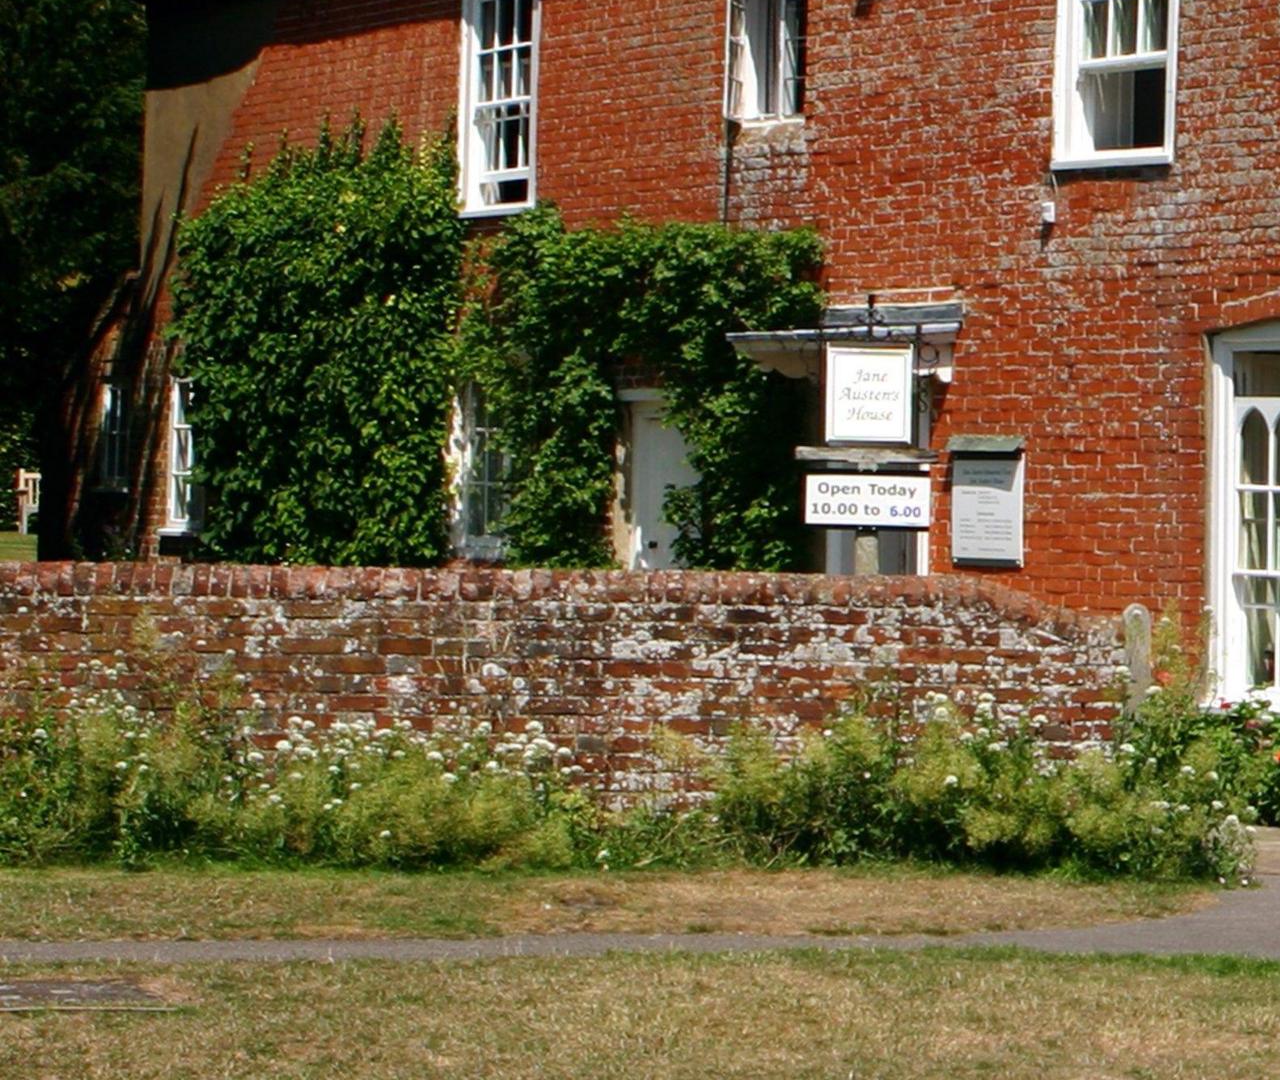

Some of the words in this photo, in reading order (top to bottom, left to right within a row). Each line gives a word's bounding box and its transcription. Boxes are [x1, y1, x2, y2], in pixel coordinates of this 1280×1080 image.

[853, 368, 889, 384] Jane
[846, 405, 893, 421] House
[817, 482, 861, 497] Open
[868, 483, 917, 498] Today
[811, 502, 858, 515] 10.00
[864, 504, 880, 516] to
[889, 505, 921, 518] 6.00
